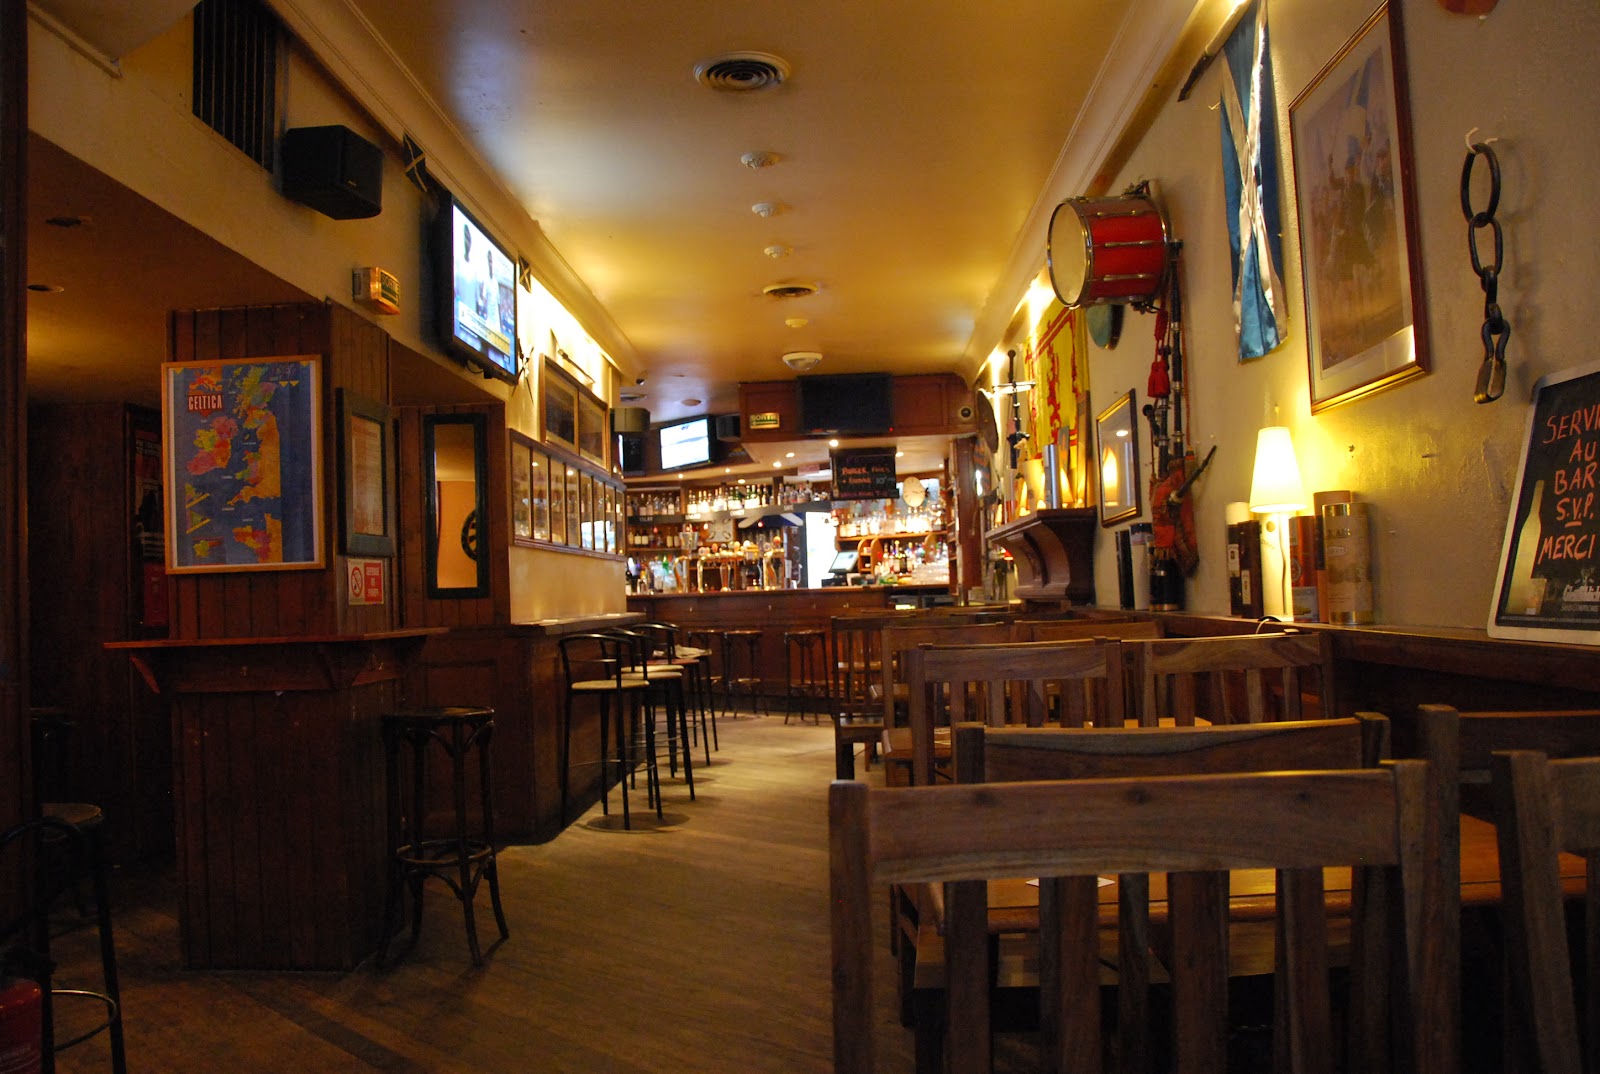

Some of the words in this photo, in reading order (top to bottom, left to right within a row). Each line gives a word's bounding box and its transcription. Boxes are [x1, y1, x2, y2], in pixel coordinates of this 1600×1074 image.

[381, 271, 400, 295] SORTIE
[188, 394, 223, 411] CELTICA
[1542, 404, 1600, 444] SERVI
[1569, 439, 1598, 463] AU
[1554, 462, 1598, 495] BAR
[1556, 492, 1594, 520] S.V.P.
[1538, 534, 1597, 564] MERCI
